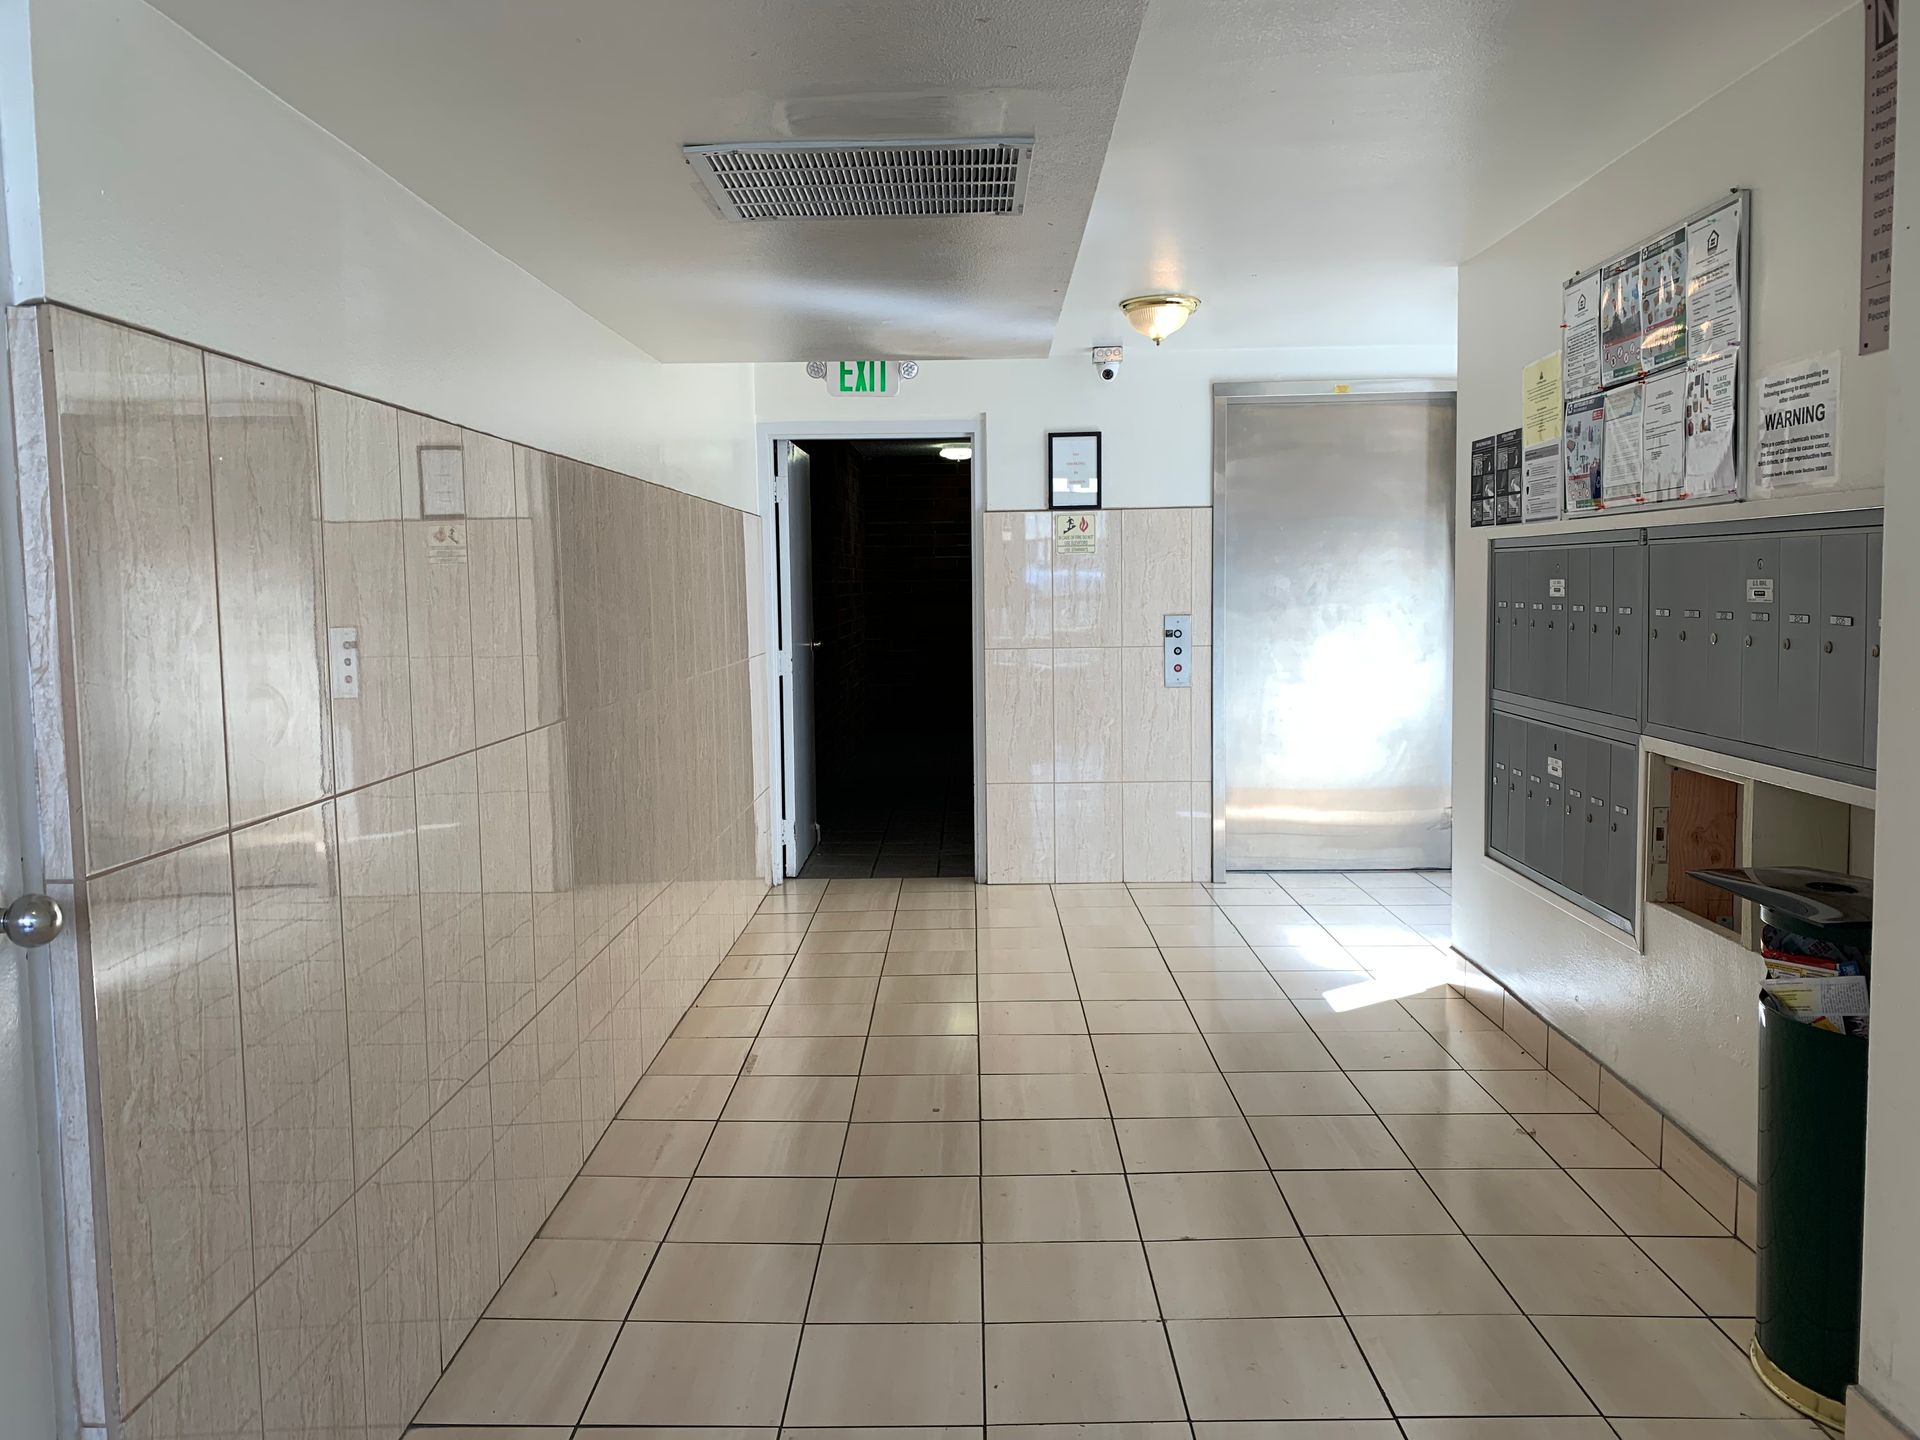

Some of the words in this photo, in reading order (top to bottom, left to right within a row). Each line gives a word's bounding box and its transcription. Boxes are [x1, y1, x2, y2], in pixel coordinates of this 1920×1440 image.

[840, 361, 886, 392] EXIT
[1765, 381, 1785, 389] Proposition
[1806, 371, 1822, 379] posting
[1764, 391, 1780, 399] following
[1800, 381, 1821, 389] employees
[1765, 403, 1825, 431] WARNING
[1790, 436, 1810, 444] chemicals
[1795, 453, 1820, 463] reproductive
